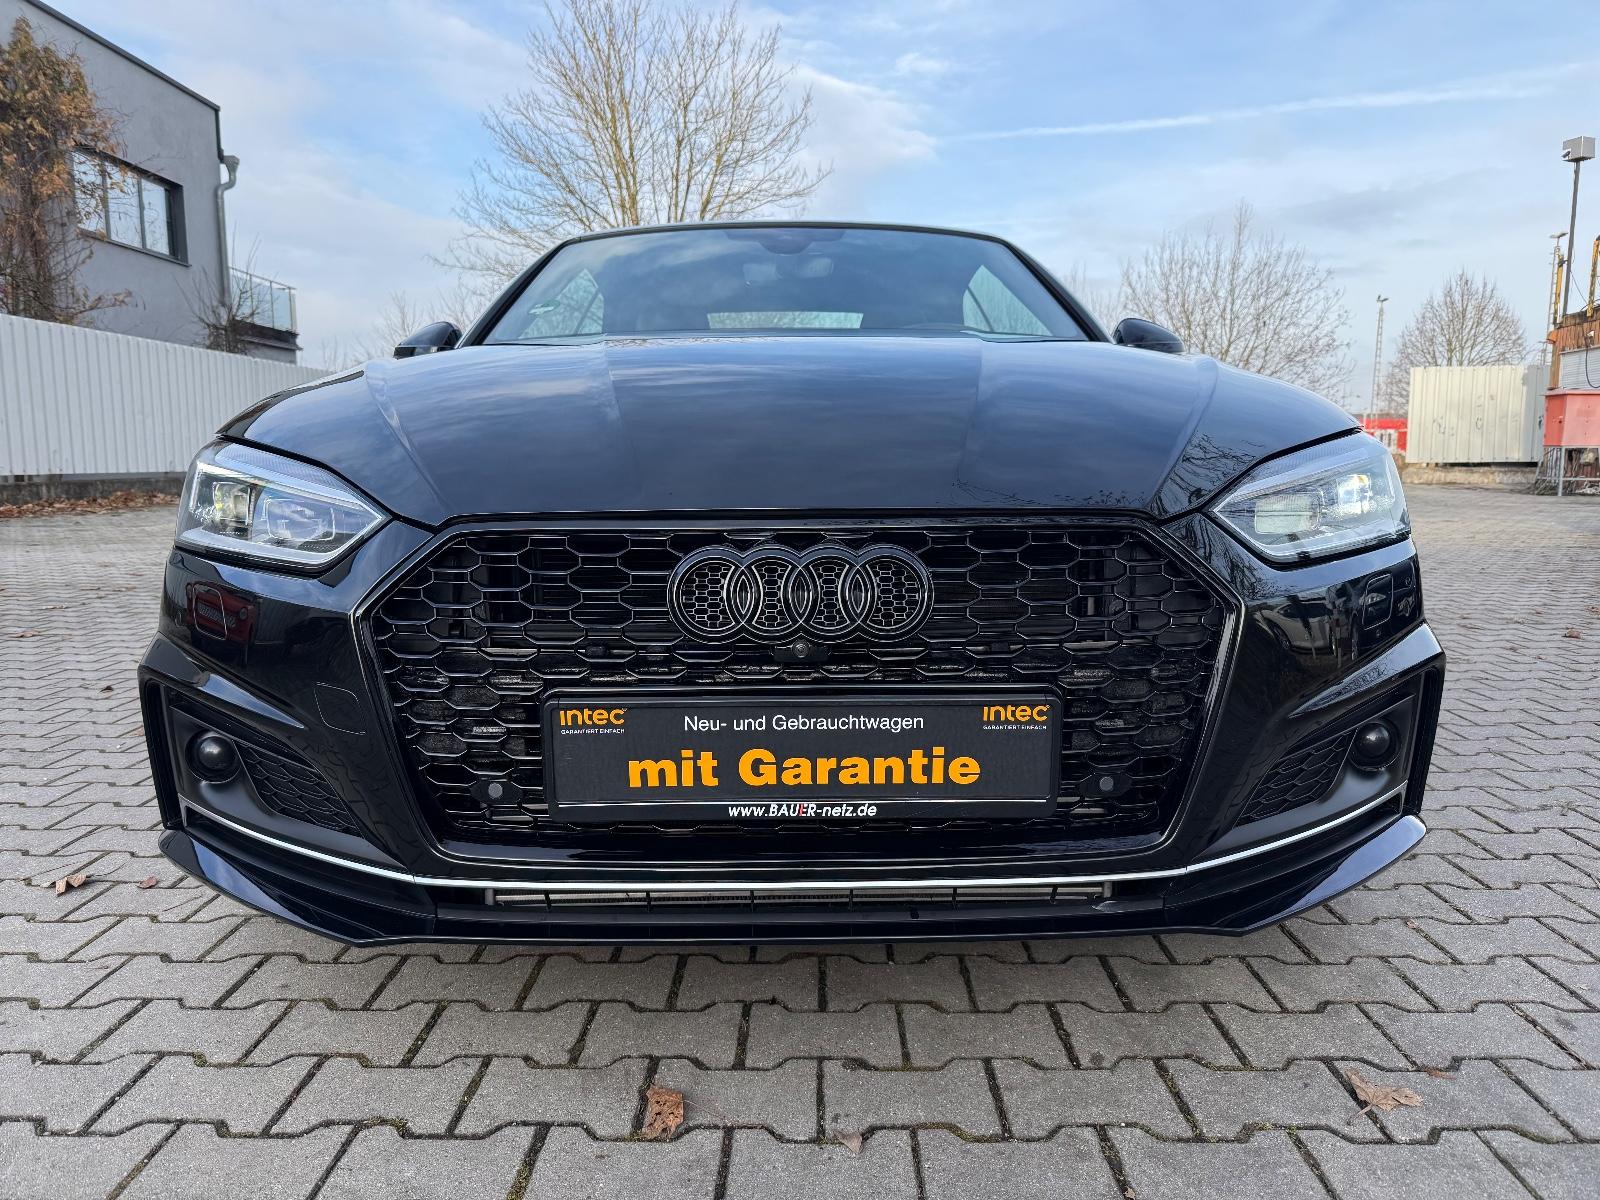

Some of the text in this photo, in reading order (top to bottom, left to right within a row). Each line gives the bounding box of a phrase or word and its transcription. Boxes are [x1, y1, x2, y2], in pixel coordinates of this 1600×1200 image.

[684, 714, 924, 733] Neu- und Gebrauchtwagen
[628, 746, 981, 788] mit Garantie
[728, 803, 878, 817] www.BAUER-netz.de
